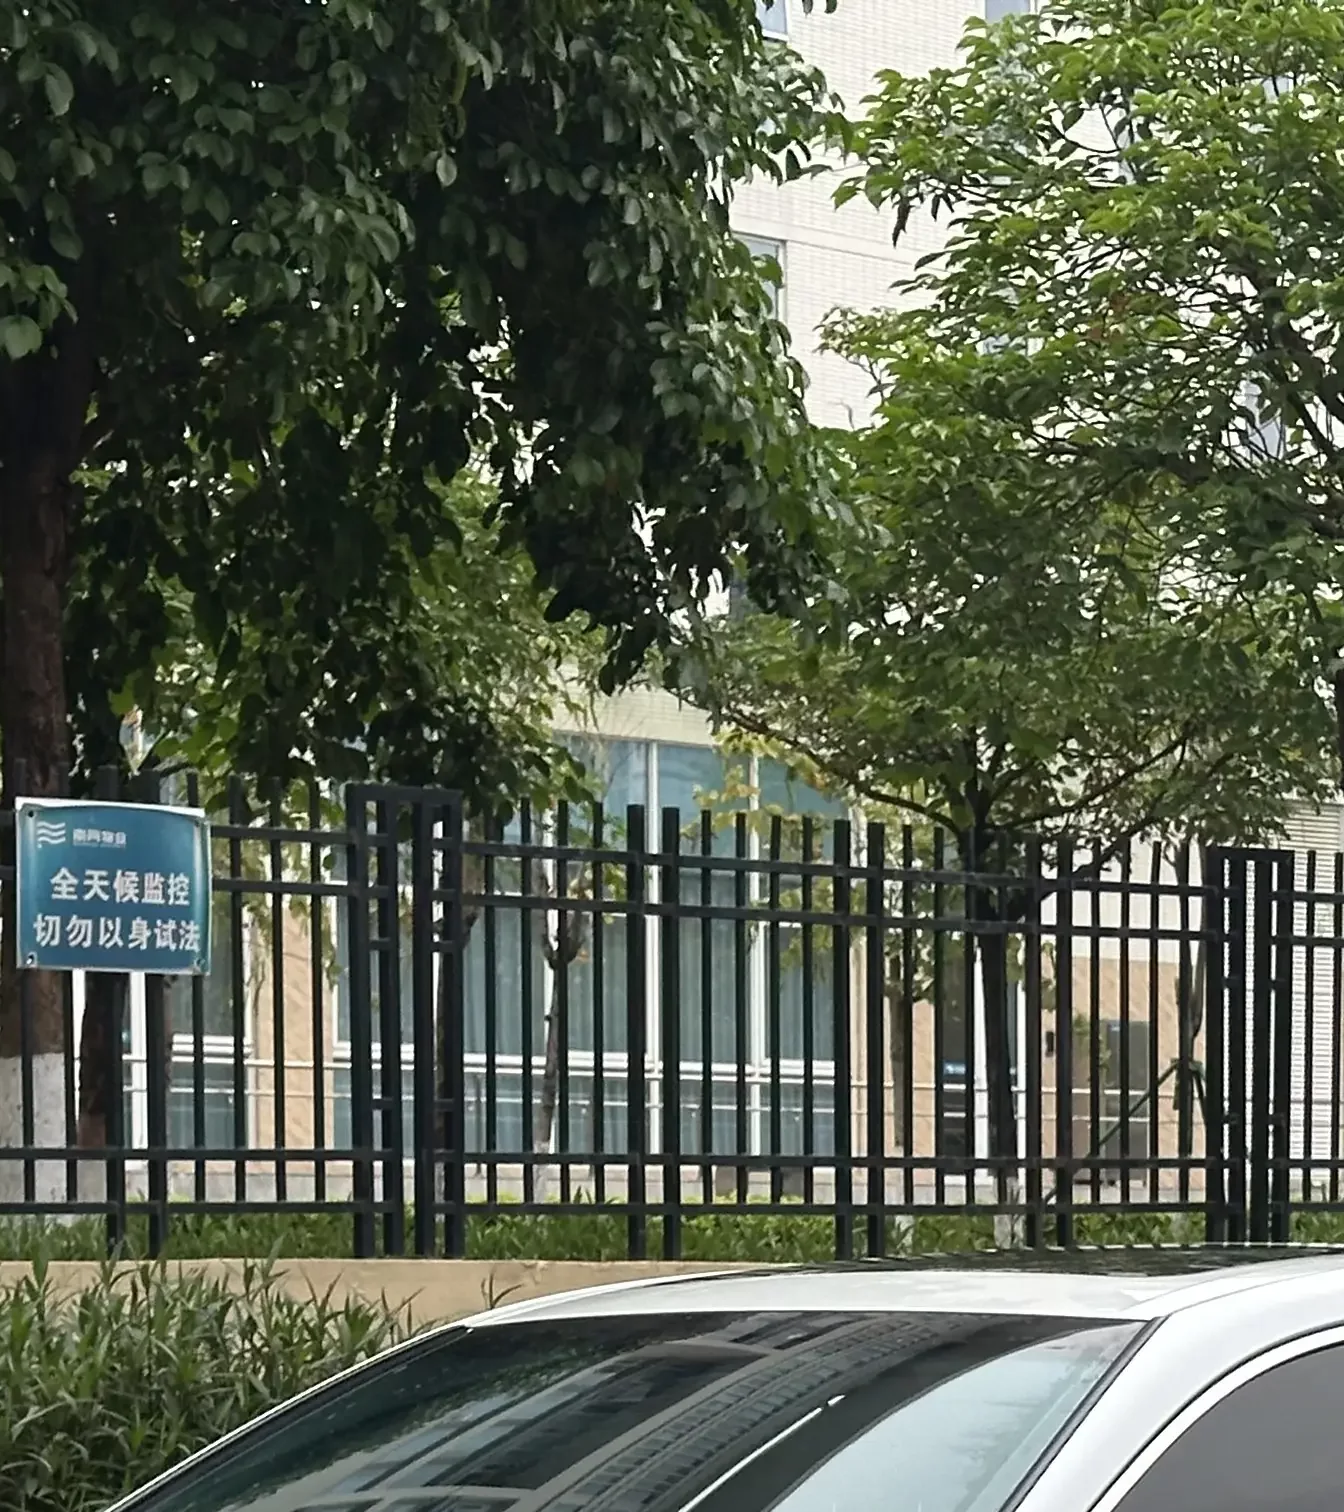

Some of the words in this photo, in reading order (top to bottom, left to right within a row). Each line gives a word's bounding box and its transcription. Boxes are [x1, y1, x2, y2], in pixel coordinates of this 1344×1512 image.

[49, 866, 191, 906] 全天候监控
[33, 913, 201, 953] 切勿以身试法
